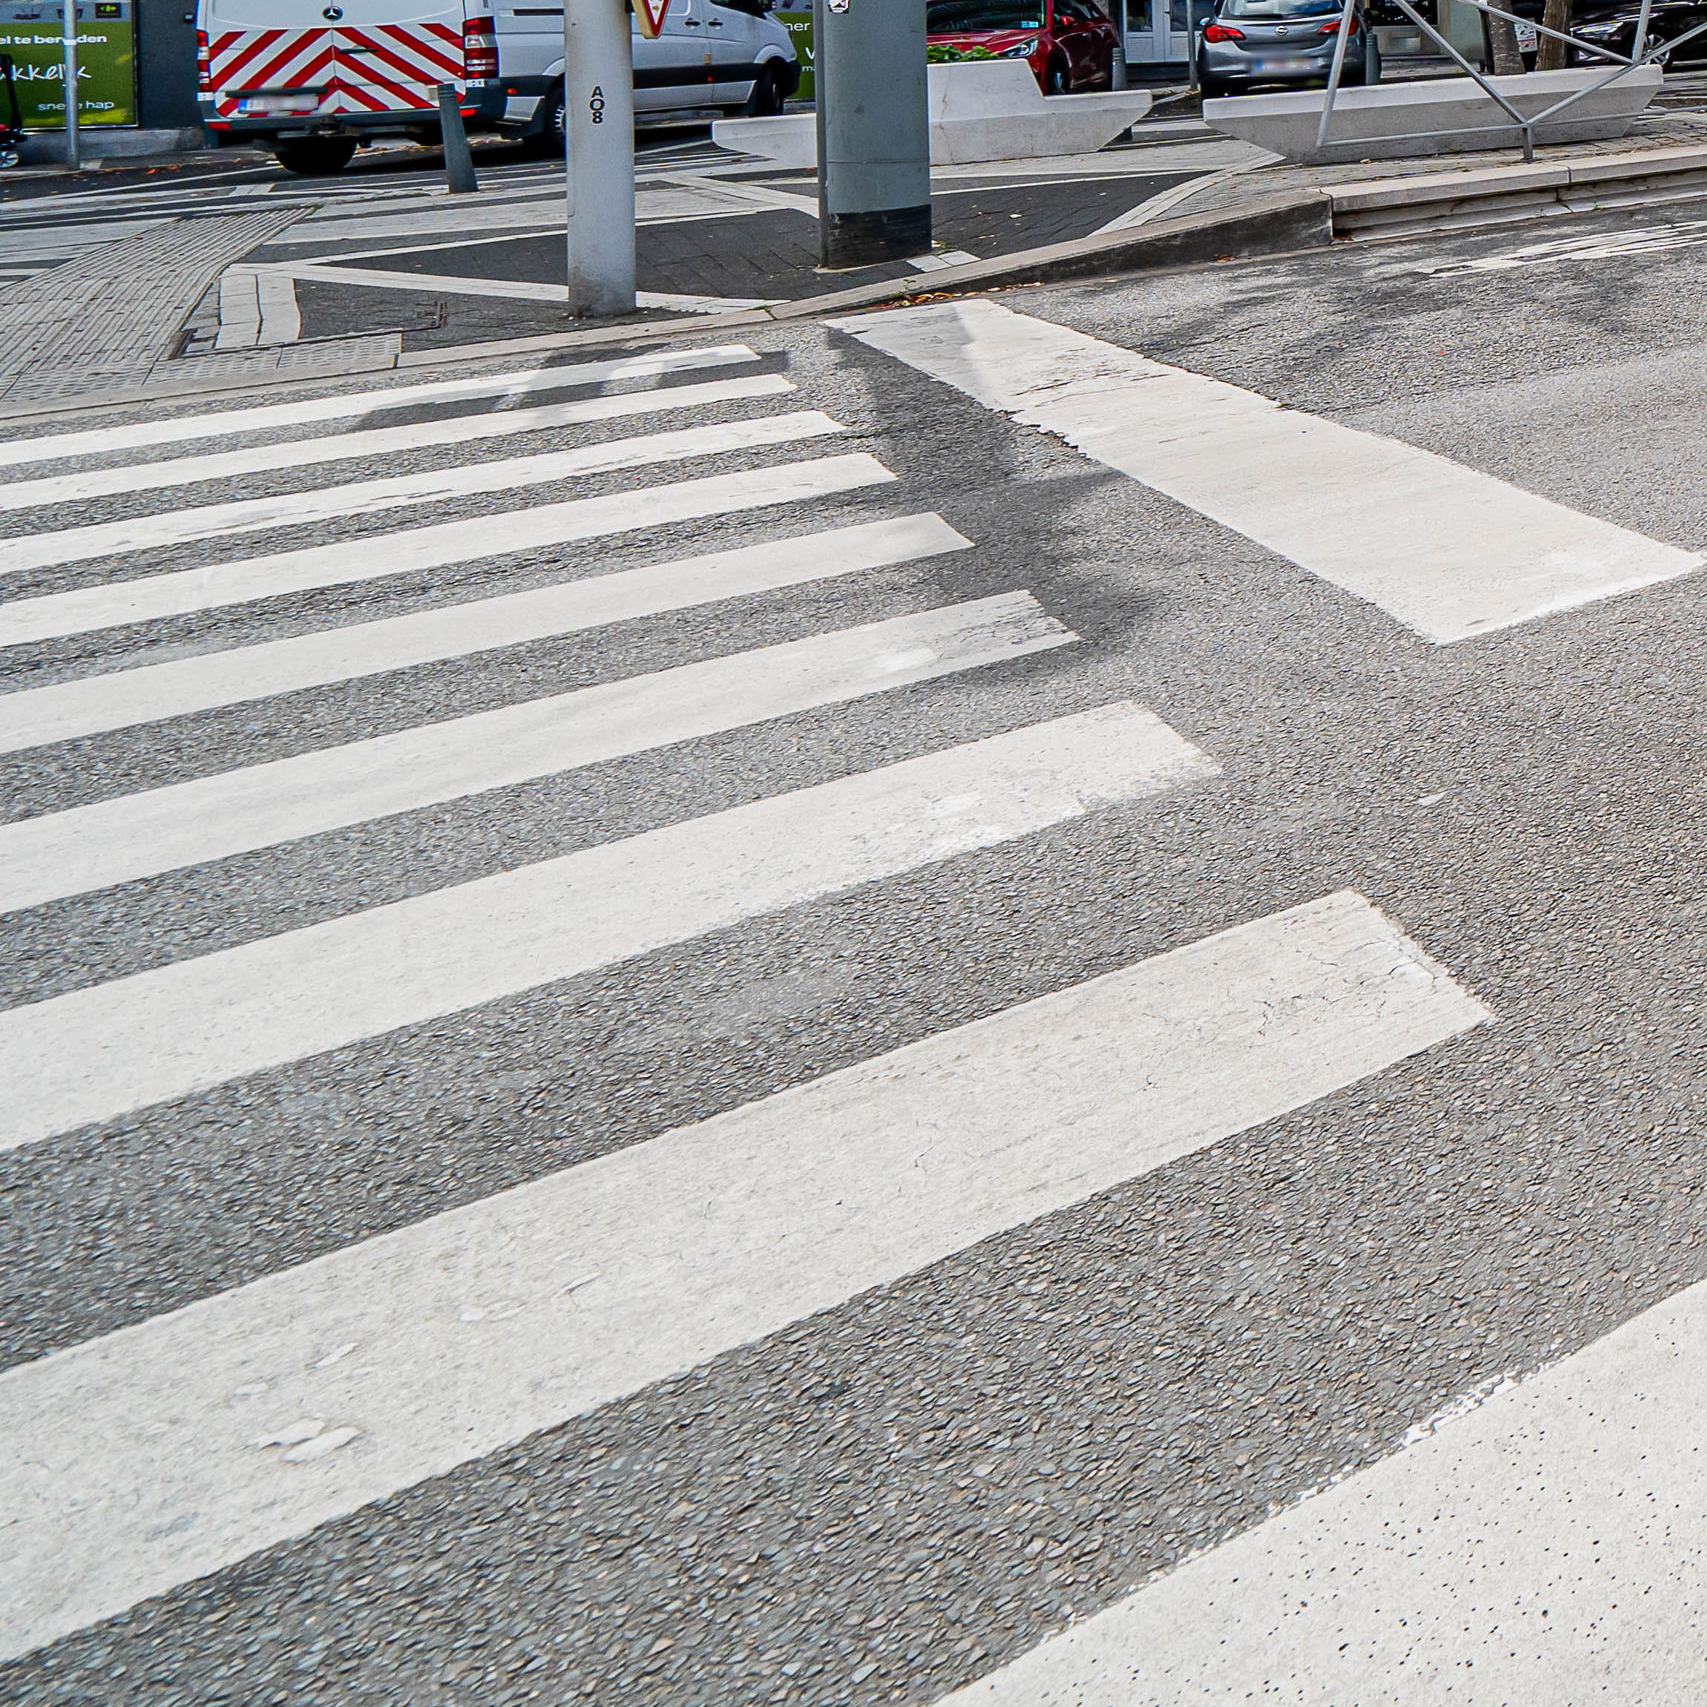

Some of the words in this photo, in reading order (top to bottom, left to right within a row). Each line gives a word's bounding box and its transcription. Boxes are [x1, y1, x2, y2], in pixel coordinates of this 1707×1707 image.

[14, 36, 31, 44] te
[33, 35, 107, 44] berden
[85, 100, 115, 112] hap
